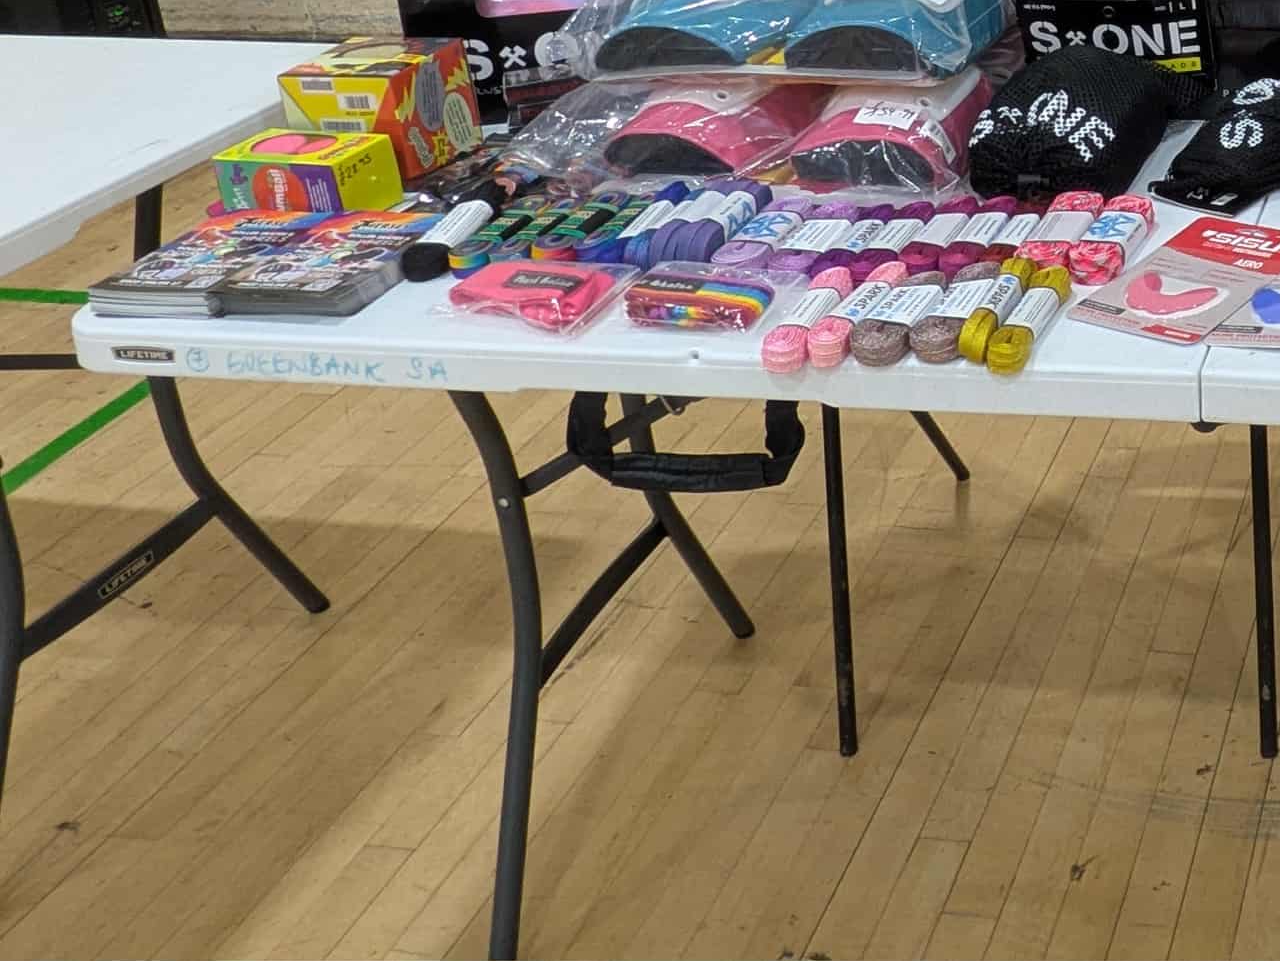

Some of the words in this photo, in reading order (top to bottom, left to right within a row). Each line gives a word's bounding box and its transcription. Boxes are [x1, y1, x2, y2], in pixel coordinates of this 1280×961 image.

[1232, 258, 1265, 270] AERO
[854, 283, 884, 309] SPARK
[119, 349, 169, 360] LIFETIME
